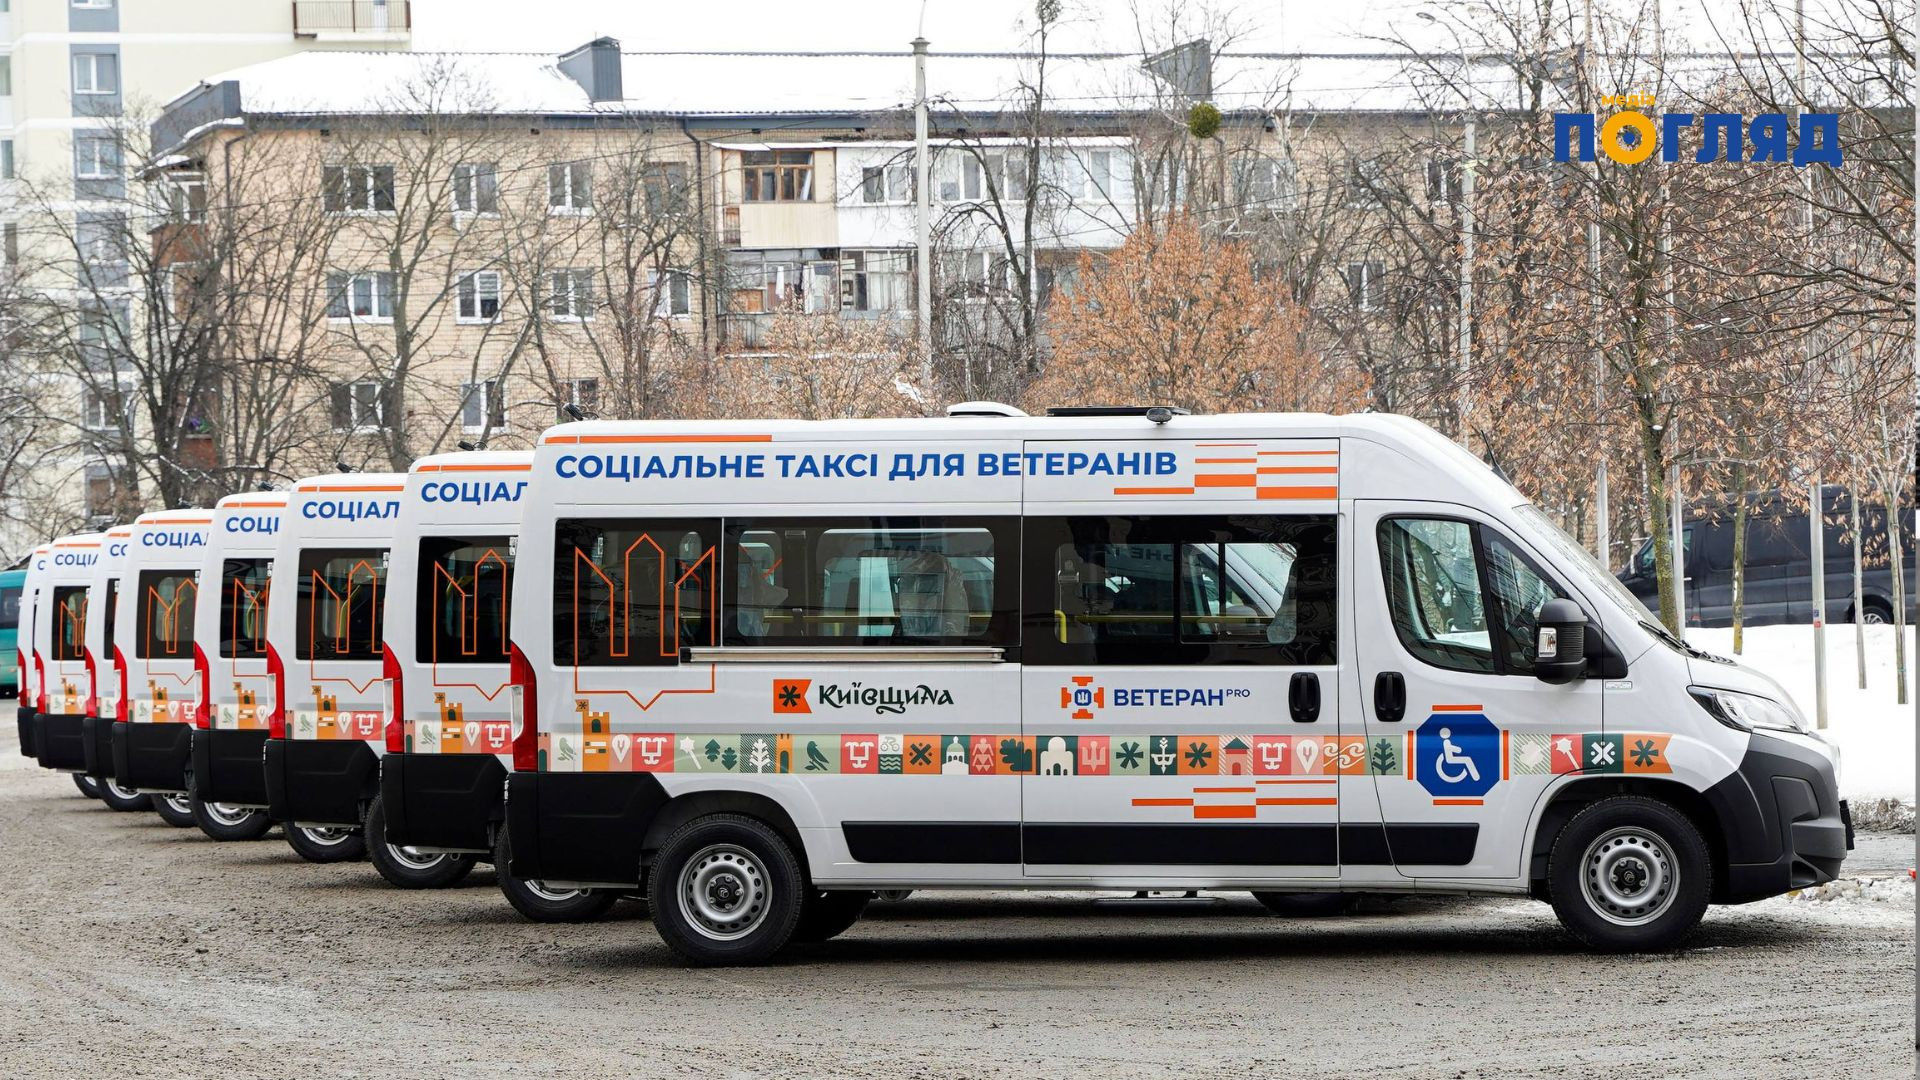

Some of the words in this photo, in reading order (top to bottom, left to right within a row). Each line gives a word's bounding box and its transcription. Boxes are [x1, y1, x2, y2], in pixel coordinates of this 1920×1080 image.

[555, 455, 765, 482] СОЦІАЛЬНЕ
[775, 454, 878, 477] ТАКСІ
[889, 453, 964, 481] ДЛЯ
[978, 452, 1177, 476] ВЕТЕРАНІВ
[302, 501, 400, 522] СОЦІАЛ
[225, 517, 279, 535] СОЦІ
[819, 682, 954, 714] Київщина
[1114, 689, 1223, 706] ВЕТЕРАН
